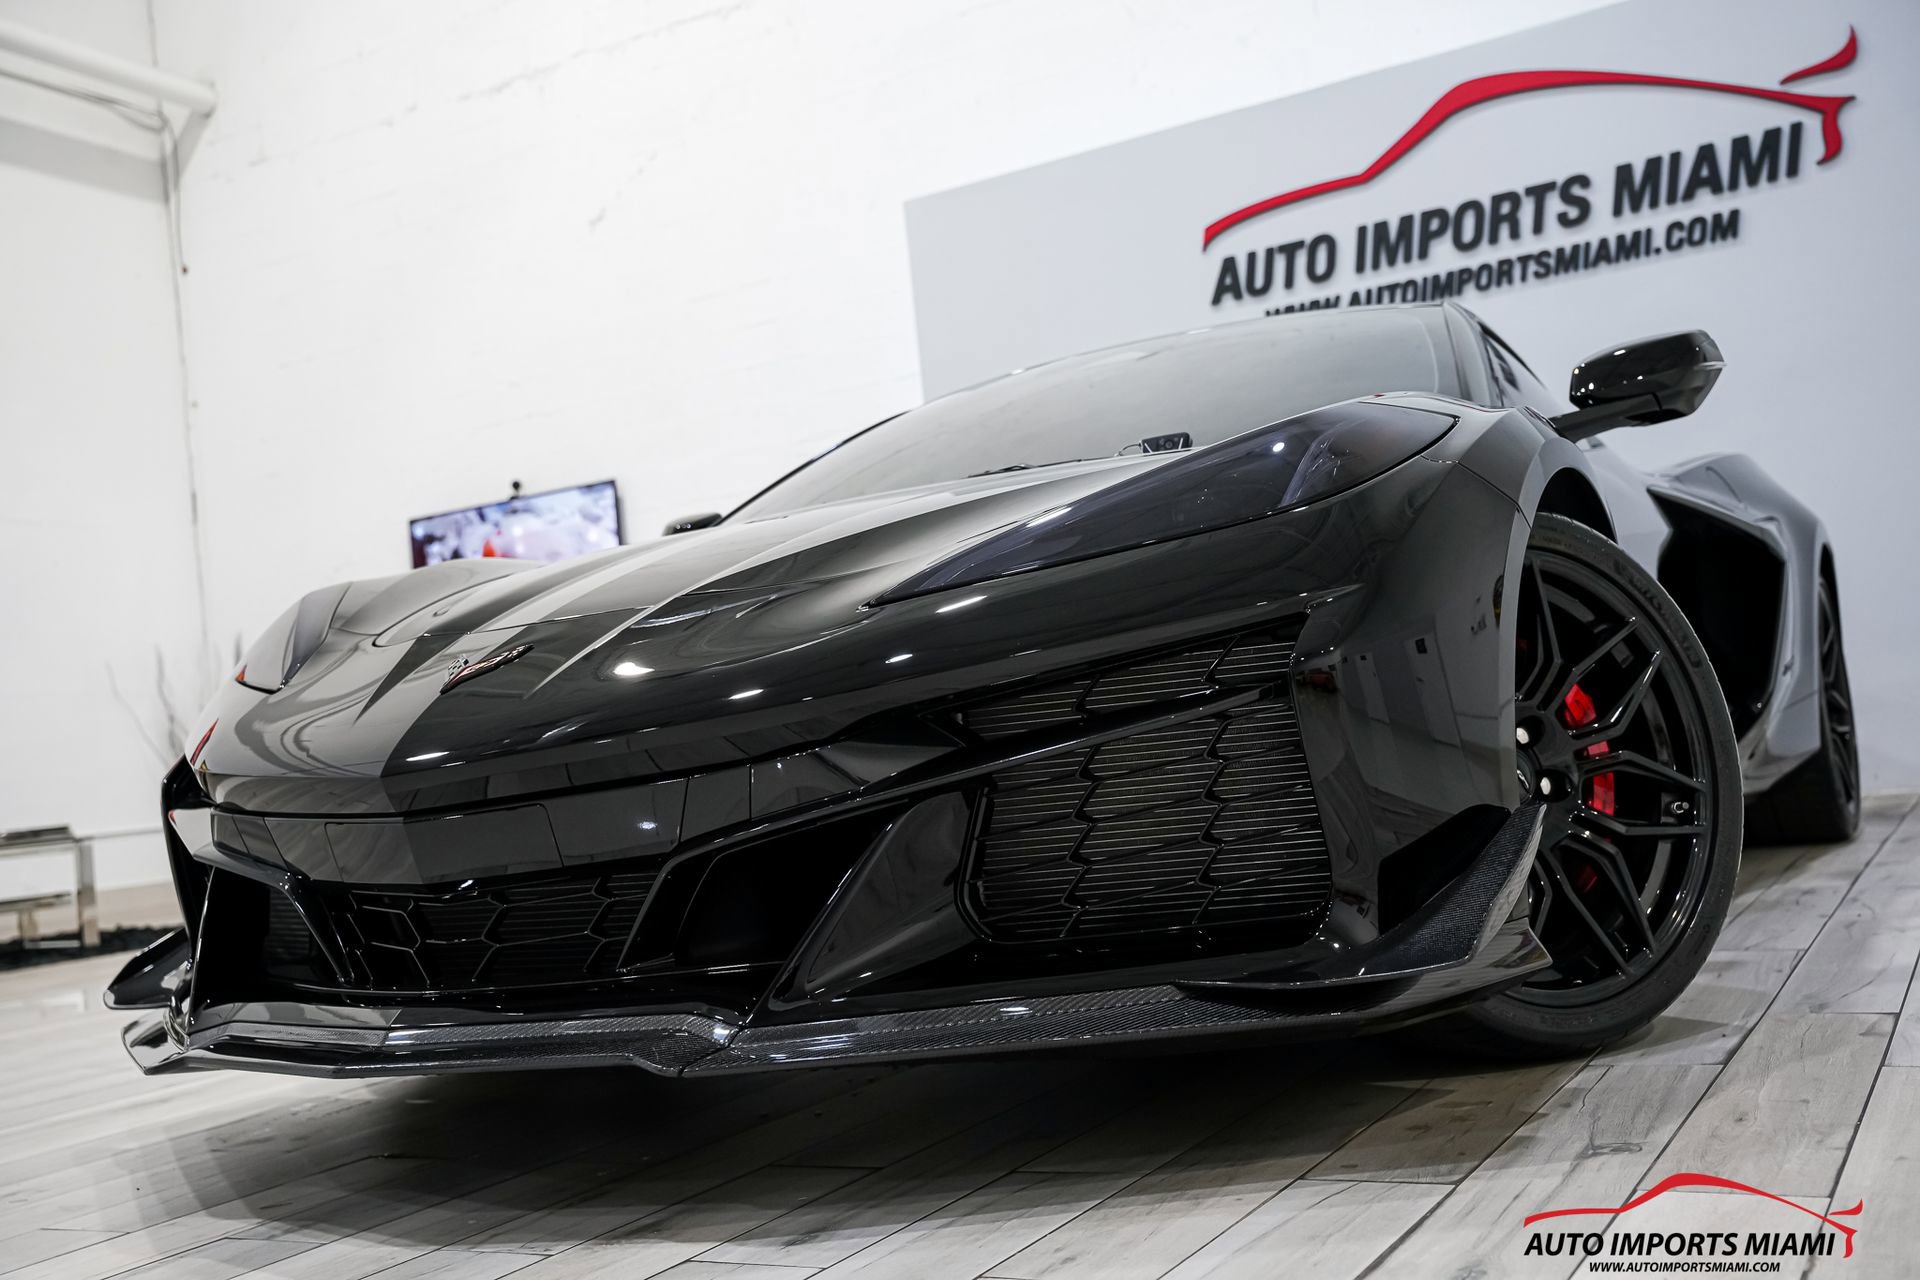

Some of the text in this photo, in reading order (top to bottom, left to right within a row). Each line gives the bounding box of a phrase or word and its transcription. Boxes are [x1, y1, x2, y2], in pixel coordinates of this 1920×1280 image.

[1211, 121, 1804, 306] AUTO IMPORTS MIAMI
